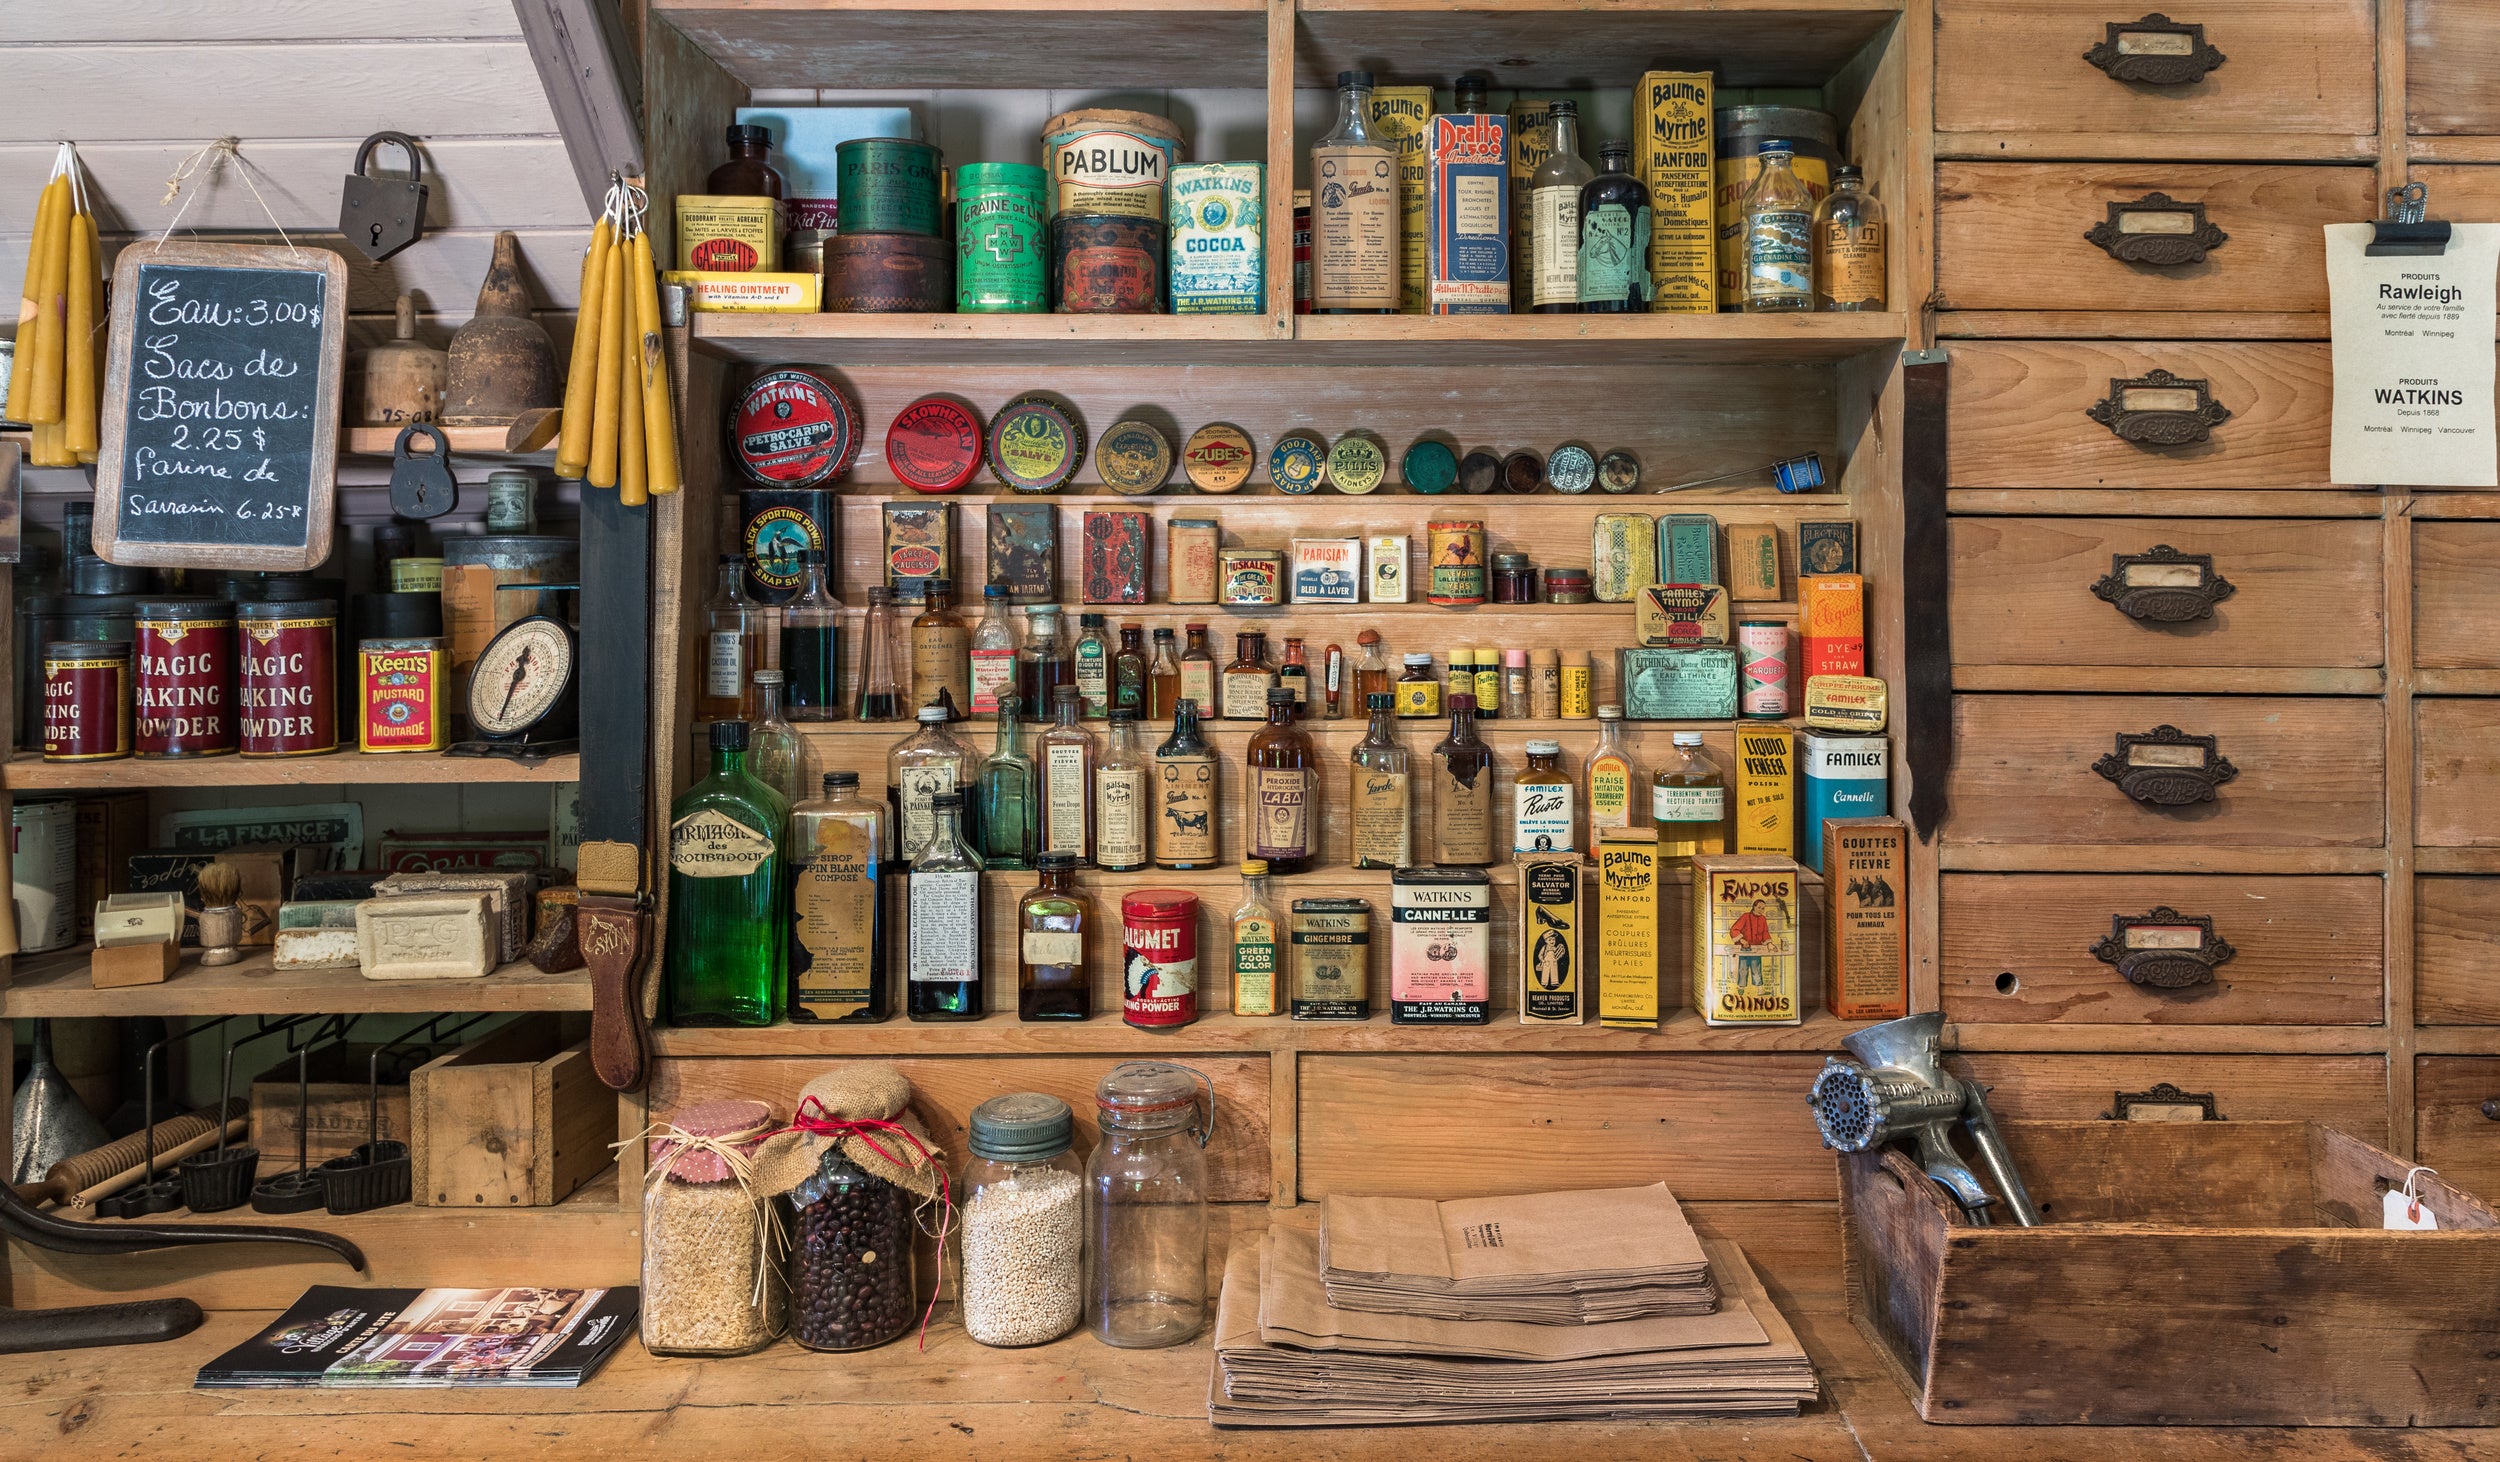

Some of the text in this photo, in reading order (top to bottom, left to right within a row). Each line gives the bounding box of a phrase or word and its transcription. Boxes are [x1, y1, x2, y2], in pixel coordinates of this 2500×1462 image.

[1653, 81, 1706, 110] Baume
[1372, 98, 1424, 122] Baume
[1654, 113, 1706, 142] Myrrhe
[1460, 143, 1502, 155] 1500
[1063, 149, 1158, 177] PABLUM
[1654, 151, 1708, 168] HANFORD
[847, 161, 901, 177] PARIS
[1661, 172, 1700, 180] PANSEMENT
[1175, 176, 1253, 197] WATKINS
[1654, 189, 1708, 203] Corps Humain
[963, 199, 1011, 223] GRAINE
[1654, 208, 1688, 217] Animaux
[685, 214, 717, 222] DEODORANT
[1663, 217, 1709, 227] Domestiques
[1186, 237, 1246, 253] COCOA
[1753, 253, 1793, 263] GRENADINE
[698, 284, 790, 295] HEALING OINTMENT
[2379, 283, 2462, 304] Rawleigh
[1177, 298, 1189, 306] THE
[2413, 303, 2422, 311] de
[2398, 312, 2416, 320] fierté
[2384, 329, 2455, 339] Montréal Winnipeg
[145, 334, 298, 380] Sacs de
[2399, 378, 2438, 386] PRODUITS
[747, 387, 818, 417] WATKINS
[2375, 388, 2463, 406] WATKINS
[2397, 409, 2421, 417] Depuis
[2364, 425, 2393, 433] Montréal
[2400, 426, 2433, 435] Winnipeg
[171, 424, 267, 451] 2.25 $
[769, 436, 812, 452] SALVE
[1280, 440, 1306, 453] FOOD
[1194, 447, 1244, 462] ZUBES
[244, 458, 279, 482] de
[1334, 461, 1379, 471] PILLS
[1339, 475, 1373, 488] KIDNEYS
[130, 494, 224, 516] Sarrasin
[746, 509, 804, 559] BLACK SPORTING
[1803, 529, 1849, 544] ELECTRIC
[899, 550, 923, 560] FARCE
[1303, 547, 1349, 562] PARISIAN
[895, 560, 935, 569] SAUCISSE
[1226, 560, 1276, 574] MUSKALENE
[755, 568, 783, 586] SNAP
[1248, 574, 1264, 582] GREAT
[1228, 586, 1273, 596] SKIN FOOD
[1301, 586, 1350, 595] BLEU LAVER
[1448, 582, 1474, 590] YEAST
[1661, 588, 1706, 598] FAMILEX
[1662, 597, 1705, 608] THYMOL
[1651, 613, 1716, 621] PASTILLES
[1827, 643, 1850, 654] DYE
[140, 652, 212, 677] MAGIC
[241, 653, 303, 676] MAGIC
[369, 654, 428, 676] Keen's
[1700, 657, 1728, 669] GUSTIN
[1821, 661, 1859, 671] STRAW
[1679, 672, 1717, 680] LITHINÉE
[136, 684, 221, 707] BAKING
[372, 688, 425, 704] MUSTARD
[1826, 693, 1867, 705] FAMILEX
[136, 715, 221, 738] POWDER
[372, 721, 425, 737] MOUTARDE
[1744, 737, 1788, 757] LIQUID
[1826, 752, 1882, 767] FAMILEX
[1597, 764, 1621, 772] FAMILEX
[1744, 758, 1788, 776] VENEER
[1106, 780, 1131, 791] Balsam
[1266, 777, 1300, 785] PEROXIDE
[1594, 776, 1624, 784] FRAISE
[1594, 784, 1624, 792] IMITATION
[1106, 791, 1130, 803] Myrrh
[1594, 792, 1624, 800] STRAWBERRY
[1832, 790, 1874, 804] Cannelle
[1523, 793, 1565, 817] Rusto
[199, 822, 330, 843] La FRANCE
[707, 841, 728, 850] des
[1842, 837, 1897, 849] GOUTTES
[820, 854, 853, 862] SIROP
[1603, 851, 1652, 869] Baume
[809, 864, 865, 873] PIN BLANC
[814, 873, 859, 882] COMPOSÉ
[1605, 868, 1651, 889] Myrrhe
[1721, 878, 1790, 903] EMPOIS
[1413, 891, 1472, 903] WATKINS
[1605, 895, 1651, 903] HANFORD
[1404, 910, 1477, 921] CANNELLE
[1846, 911, 1895, 920] POUR TOUS LES
[1306, 918, 1350, 928] WATKINS
[1856, 920, 1885, 928] ANIMAUX
[1123, 928, 1181, 949] ALUMET
[1241, 935, 1270, 943] WATKINS
[1304, 934, 1353, 943] GINGEMBRE
[1606, 929, 1651, 938] COUPURES
[1607, 939, 1648, 948] BRÛLURES
[1238, 947, 1272, 955] GREEN
[1241, 954, 1270, 962] FOOD
[1238, 962, 1272, 970] COLOR
[1142, 1001, 1180, 1012] POWDER
[1722, 994, 1790, 1012] CHINOIS
[1420, 1006, 1466, 1014] J.R.WATKINS
[336, 1311, 397, 1354] CARTE DU SITE
